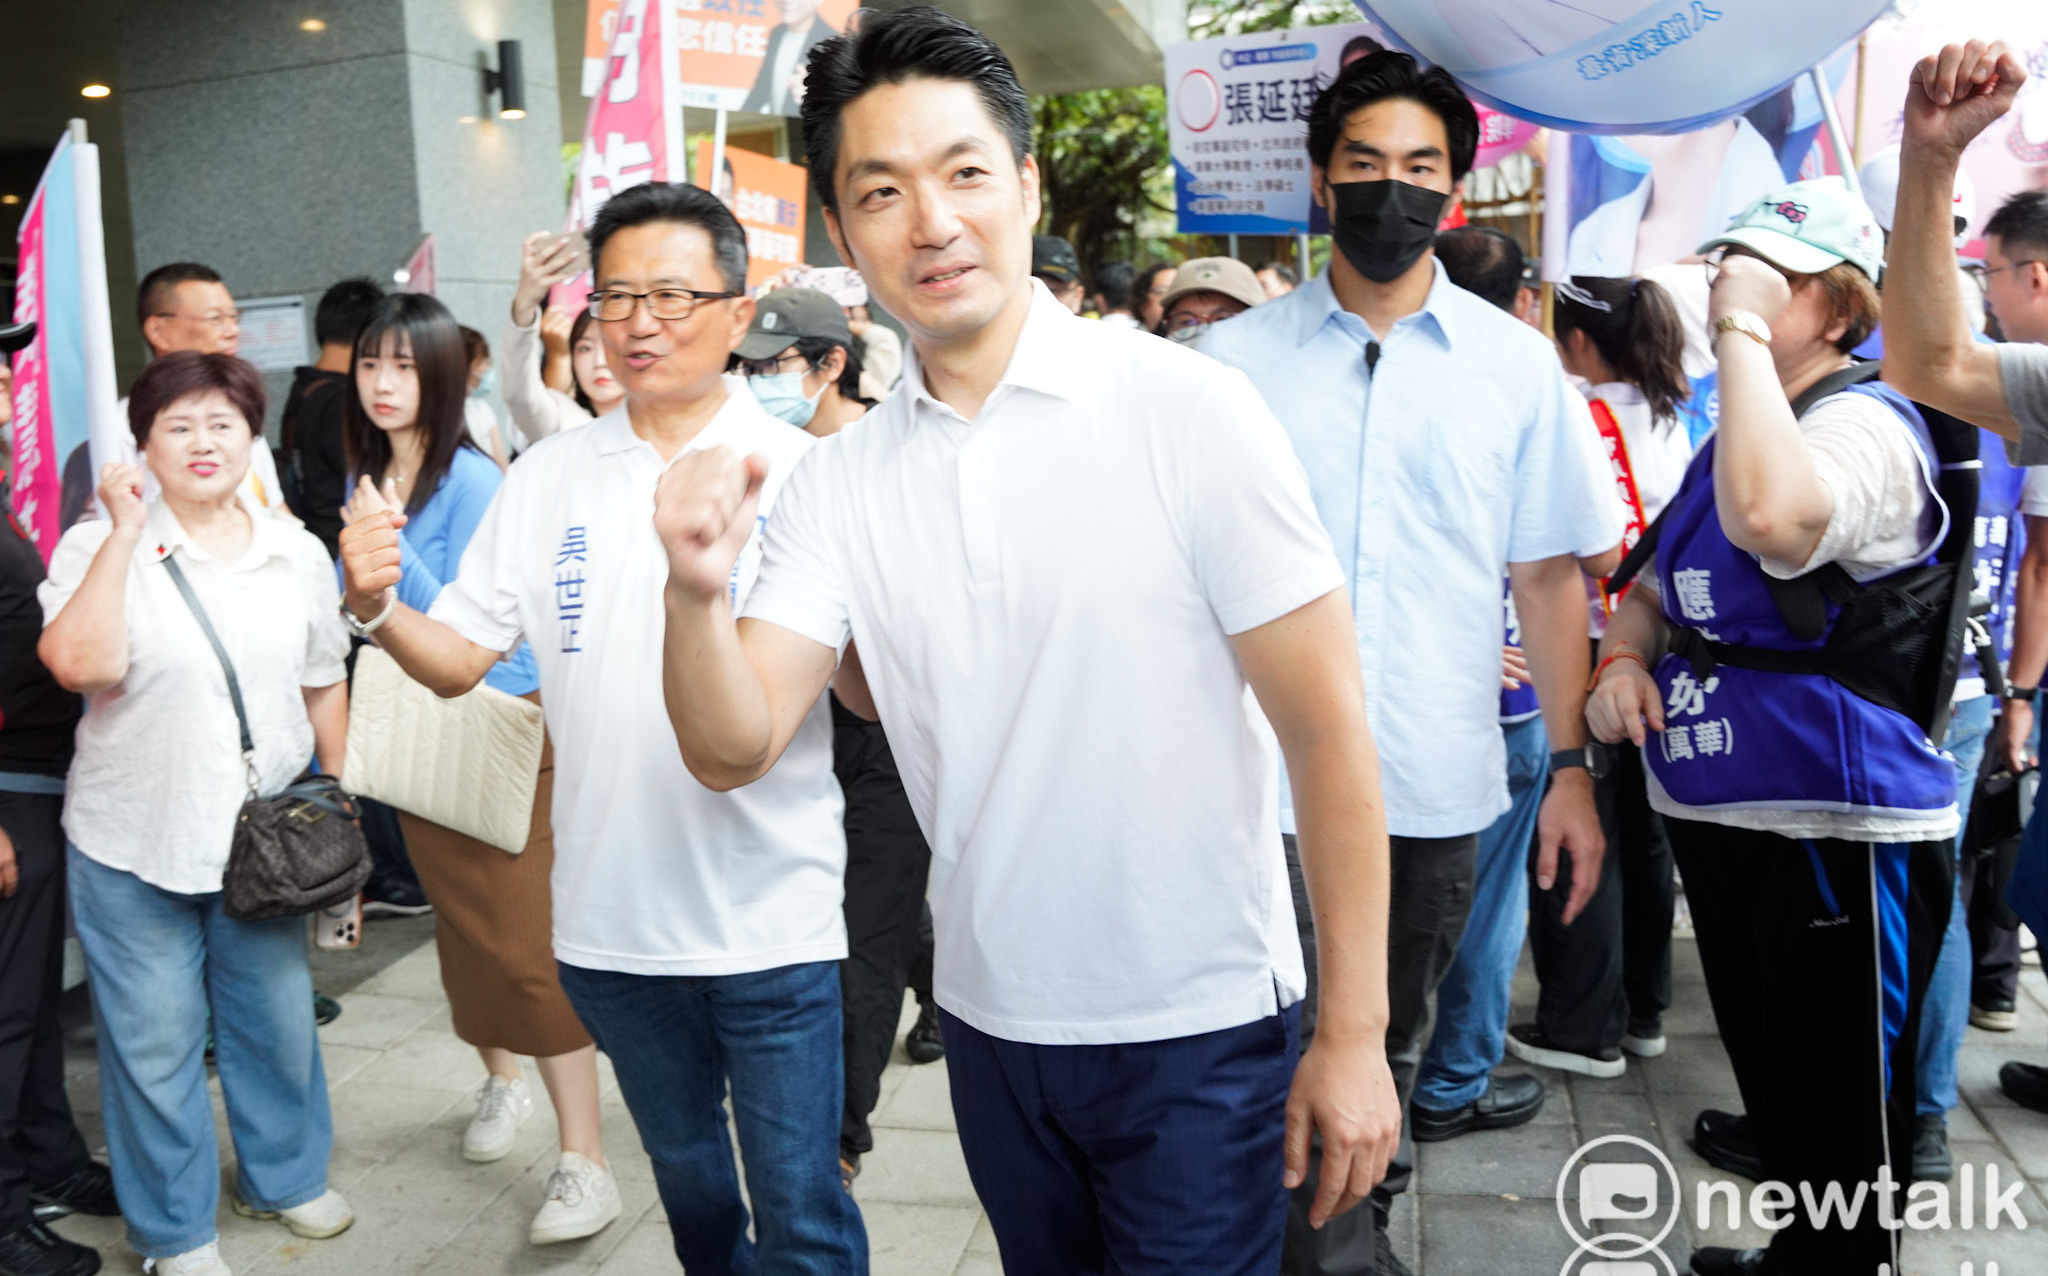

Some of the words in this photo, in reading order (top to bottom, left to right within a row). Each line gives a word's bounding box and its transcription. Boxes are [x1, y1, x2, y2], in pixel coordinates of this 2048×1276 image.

[1224, 76, 1317, 125] 張延廷
[555, 525, 588, 653] 吳世正
[1659, 716, 1734, 764] (萬華)
